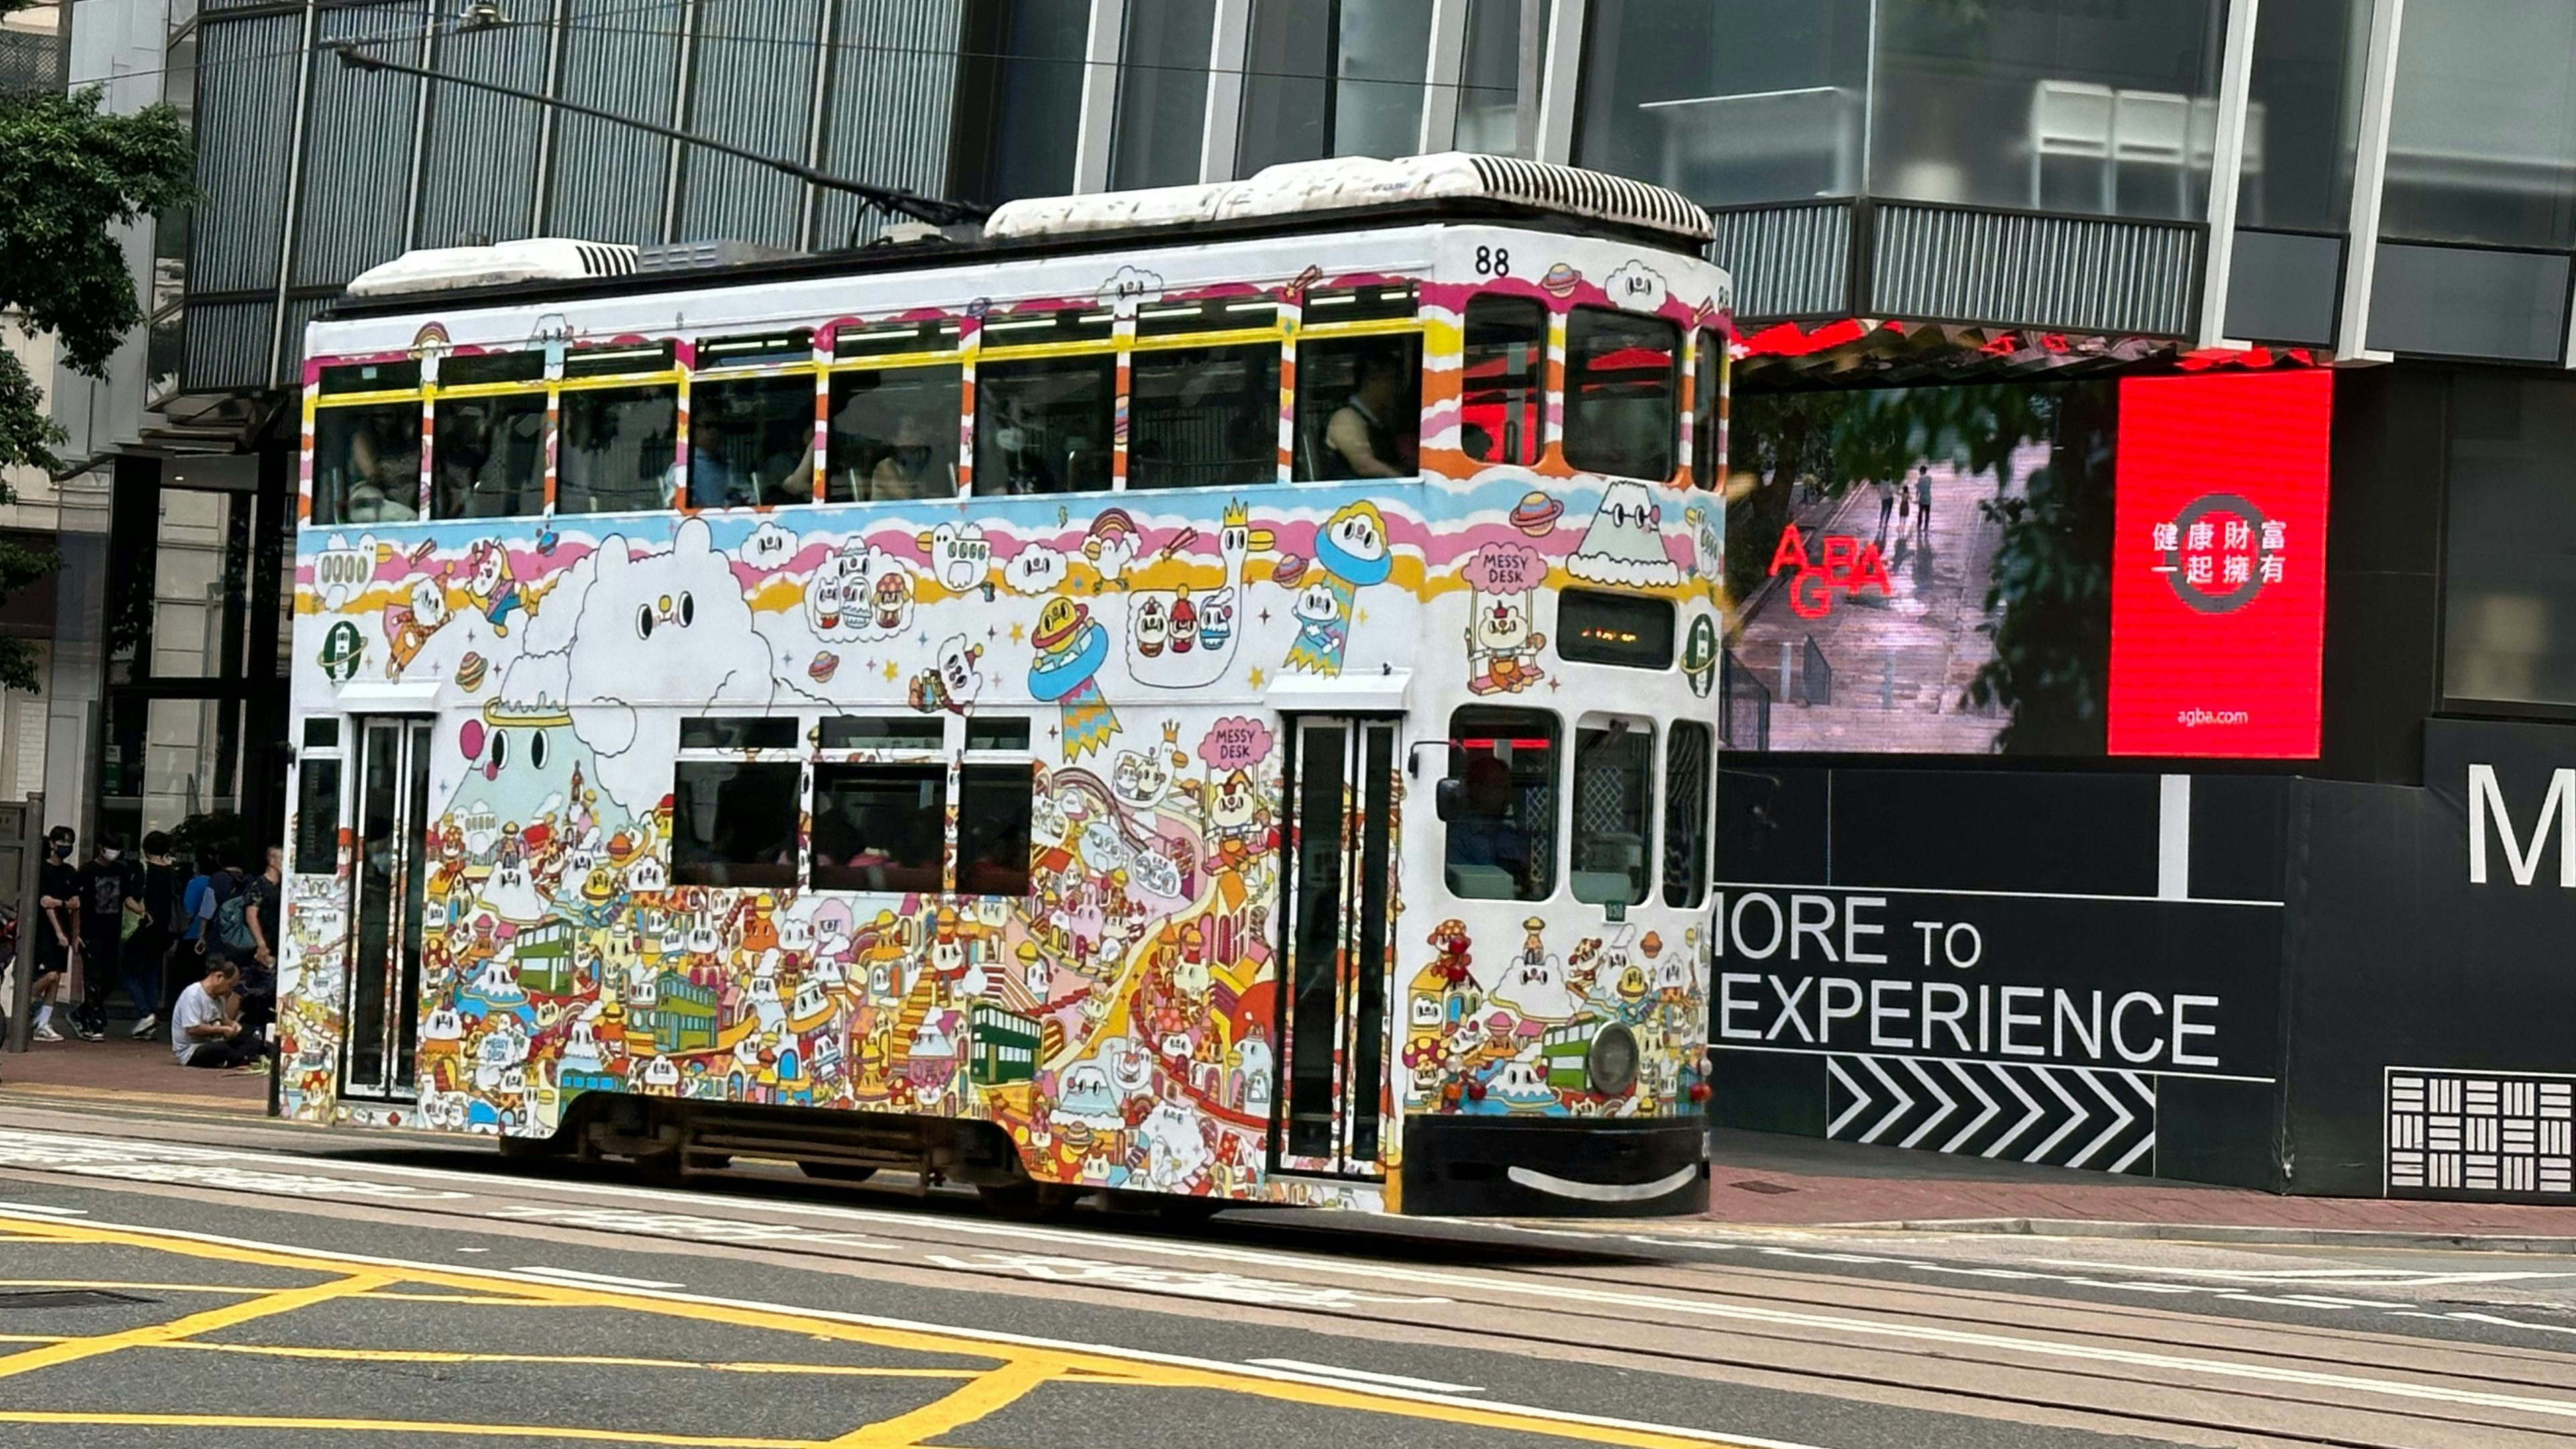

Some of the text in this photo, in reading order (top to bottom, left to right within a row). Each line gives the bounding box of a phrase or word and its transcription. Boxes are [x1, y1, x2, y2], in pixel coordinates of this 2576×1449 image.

[1475, 246, 1509, 277] 88
[2152, 519, 2287, 551] 健康財富
[1483, 553, 1529, 570] MESSY
[2151, 553, 2286, 584] 一起擁有
[1489, 568, 1523, 584] DESK
[2177, 706, 2249, 728] agba.com
[1216, 729, 1256, 743] MESSY
[1220, 745, 1250, 759] DESK
[1913, 922, 1982, 968] TO
[1721, 972, 2219, 1067] EXPERIENCE
